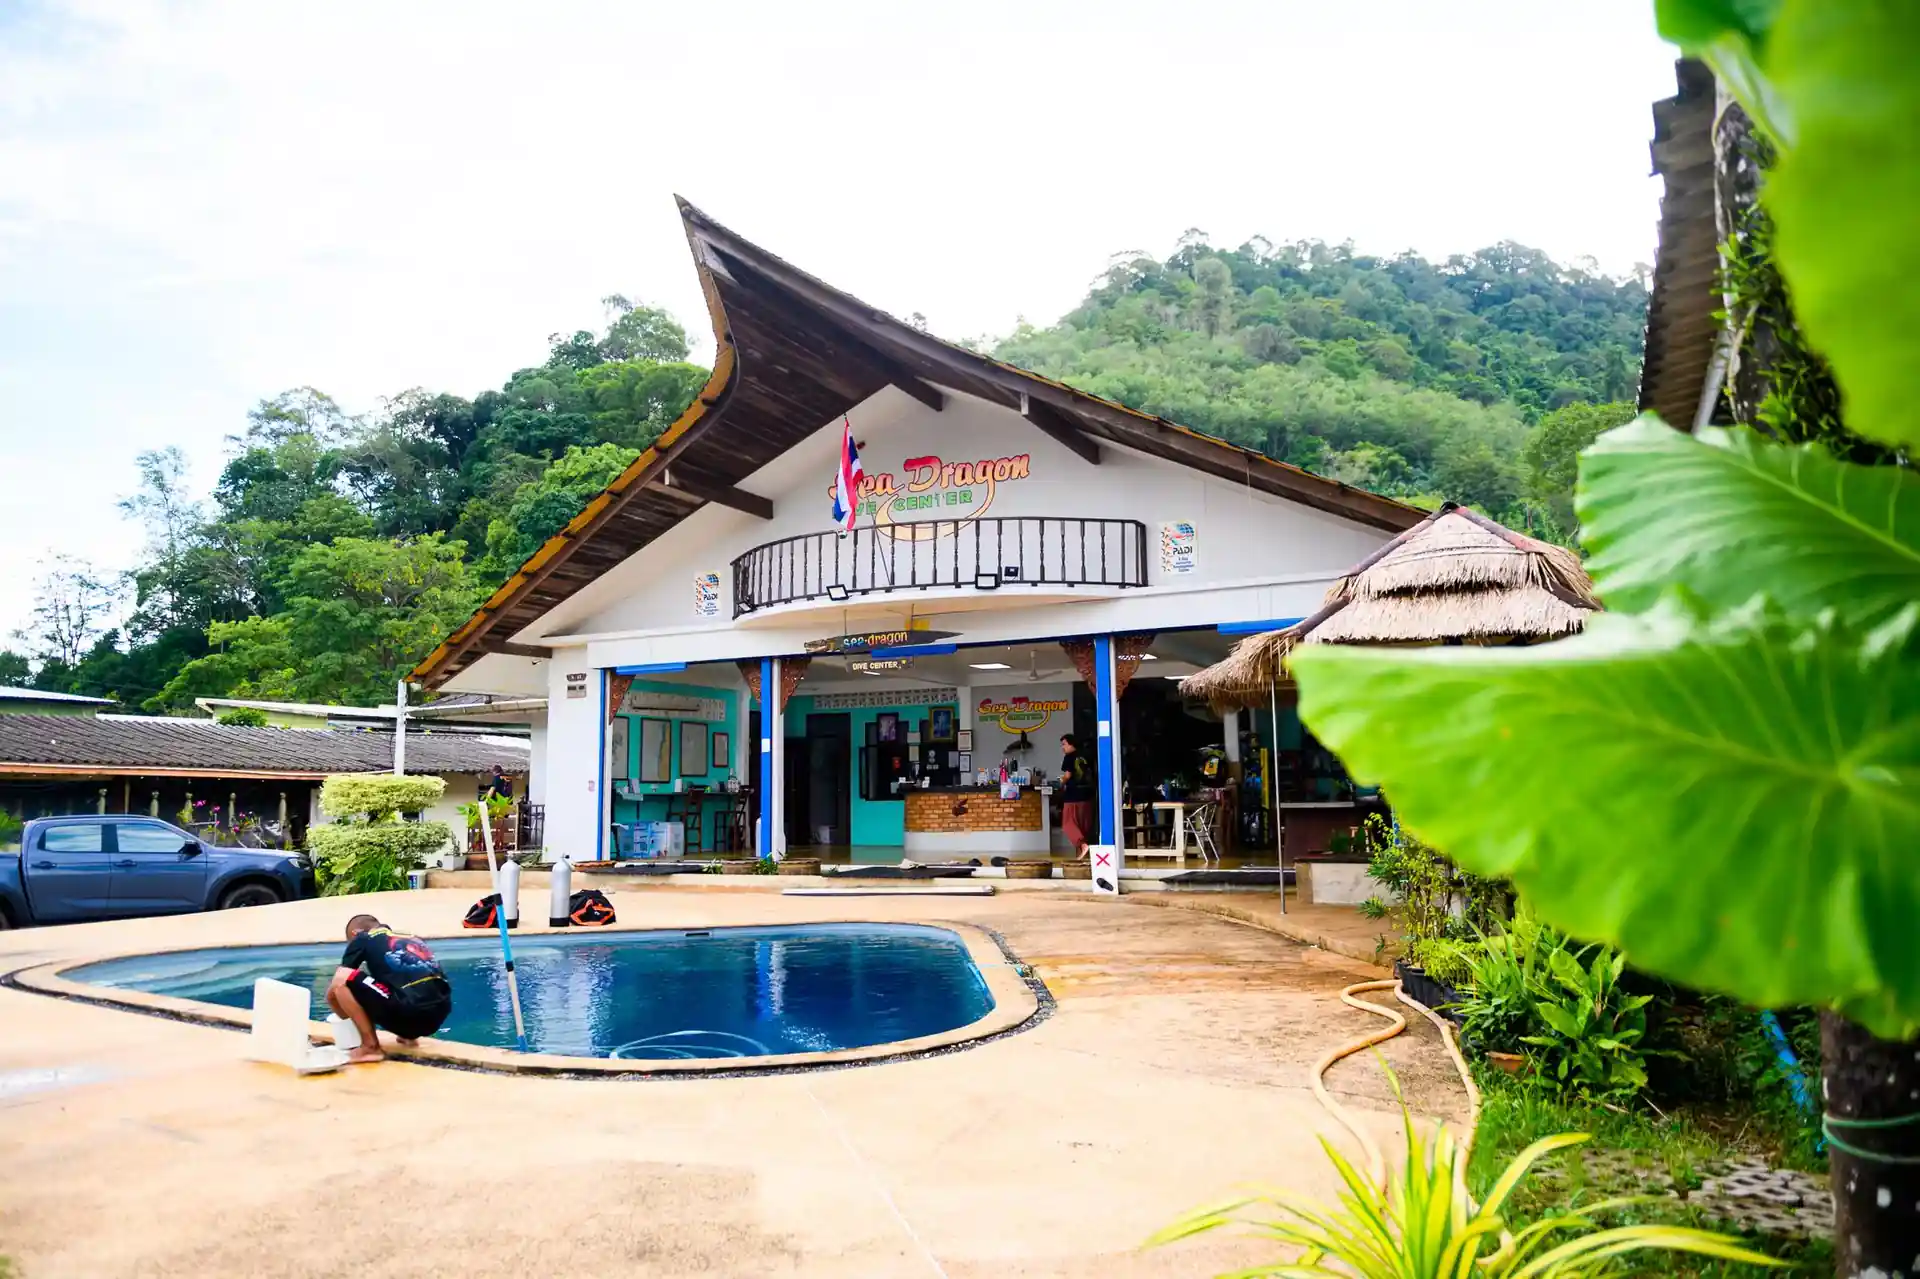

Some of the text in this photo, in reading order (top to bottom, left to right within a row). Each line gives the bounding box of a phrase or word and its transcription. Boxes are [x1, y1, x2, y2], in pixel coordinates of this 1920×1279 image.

[828, 453, 1030, 500] ea Dragon
[893, 489, 973, 512] CENTER
[1172, 545, 1193, 555] PADI
[852, 660, 898, 671] DIVE CENTER
[977, 695, 1068, 714] Sea Dragon
